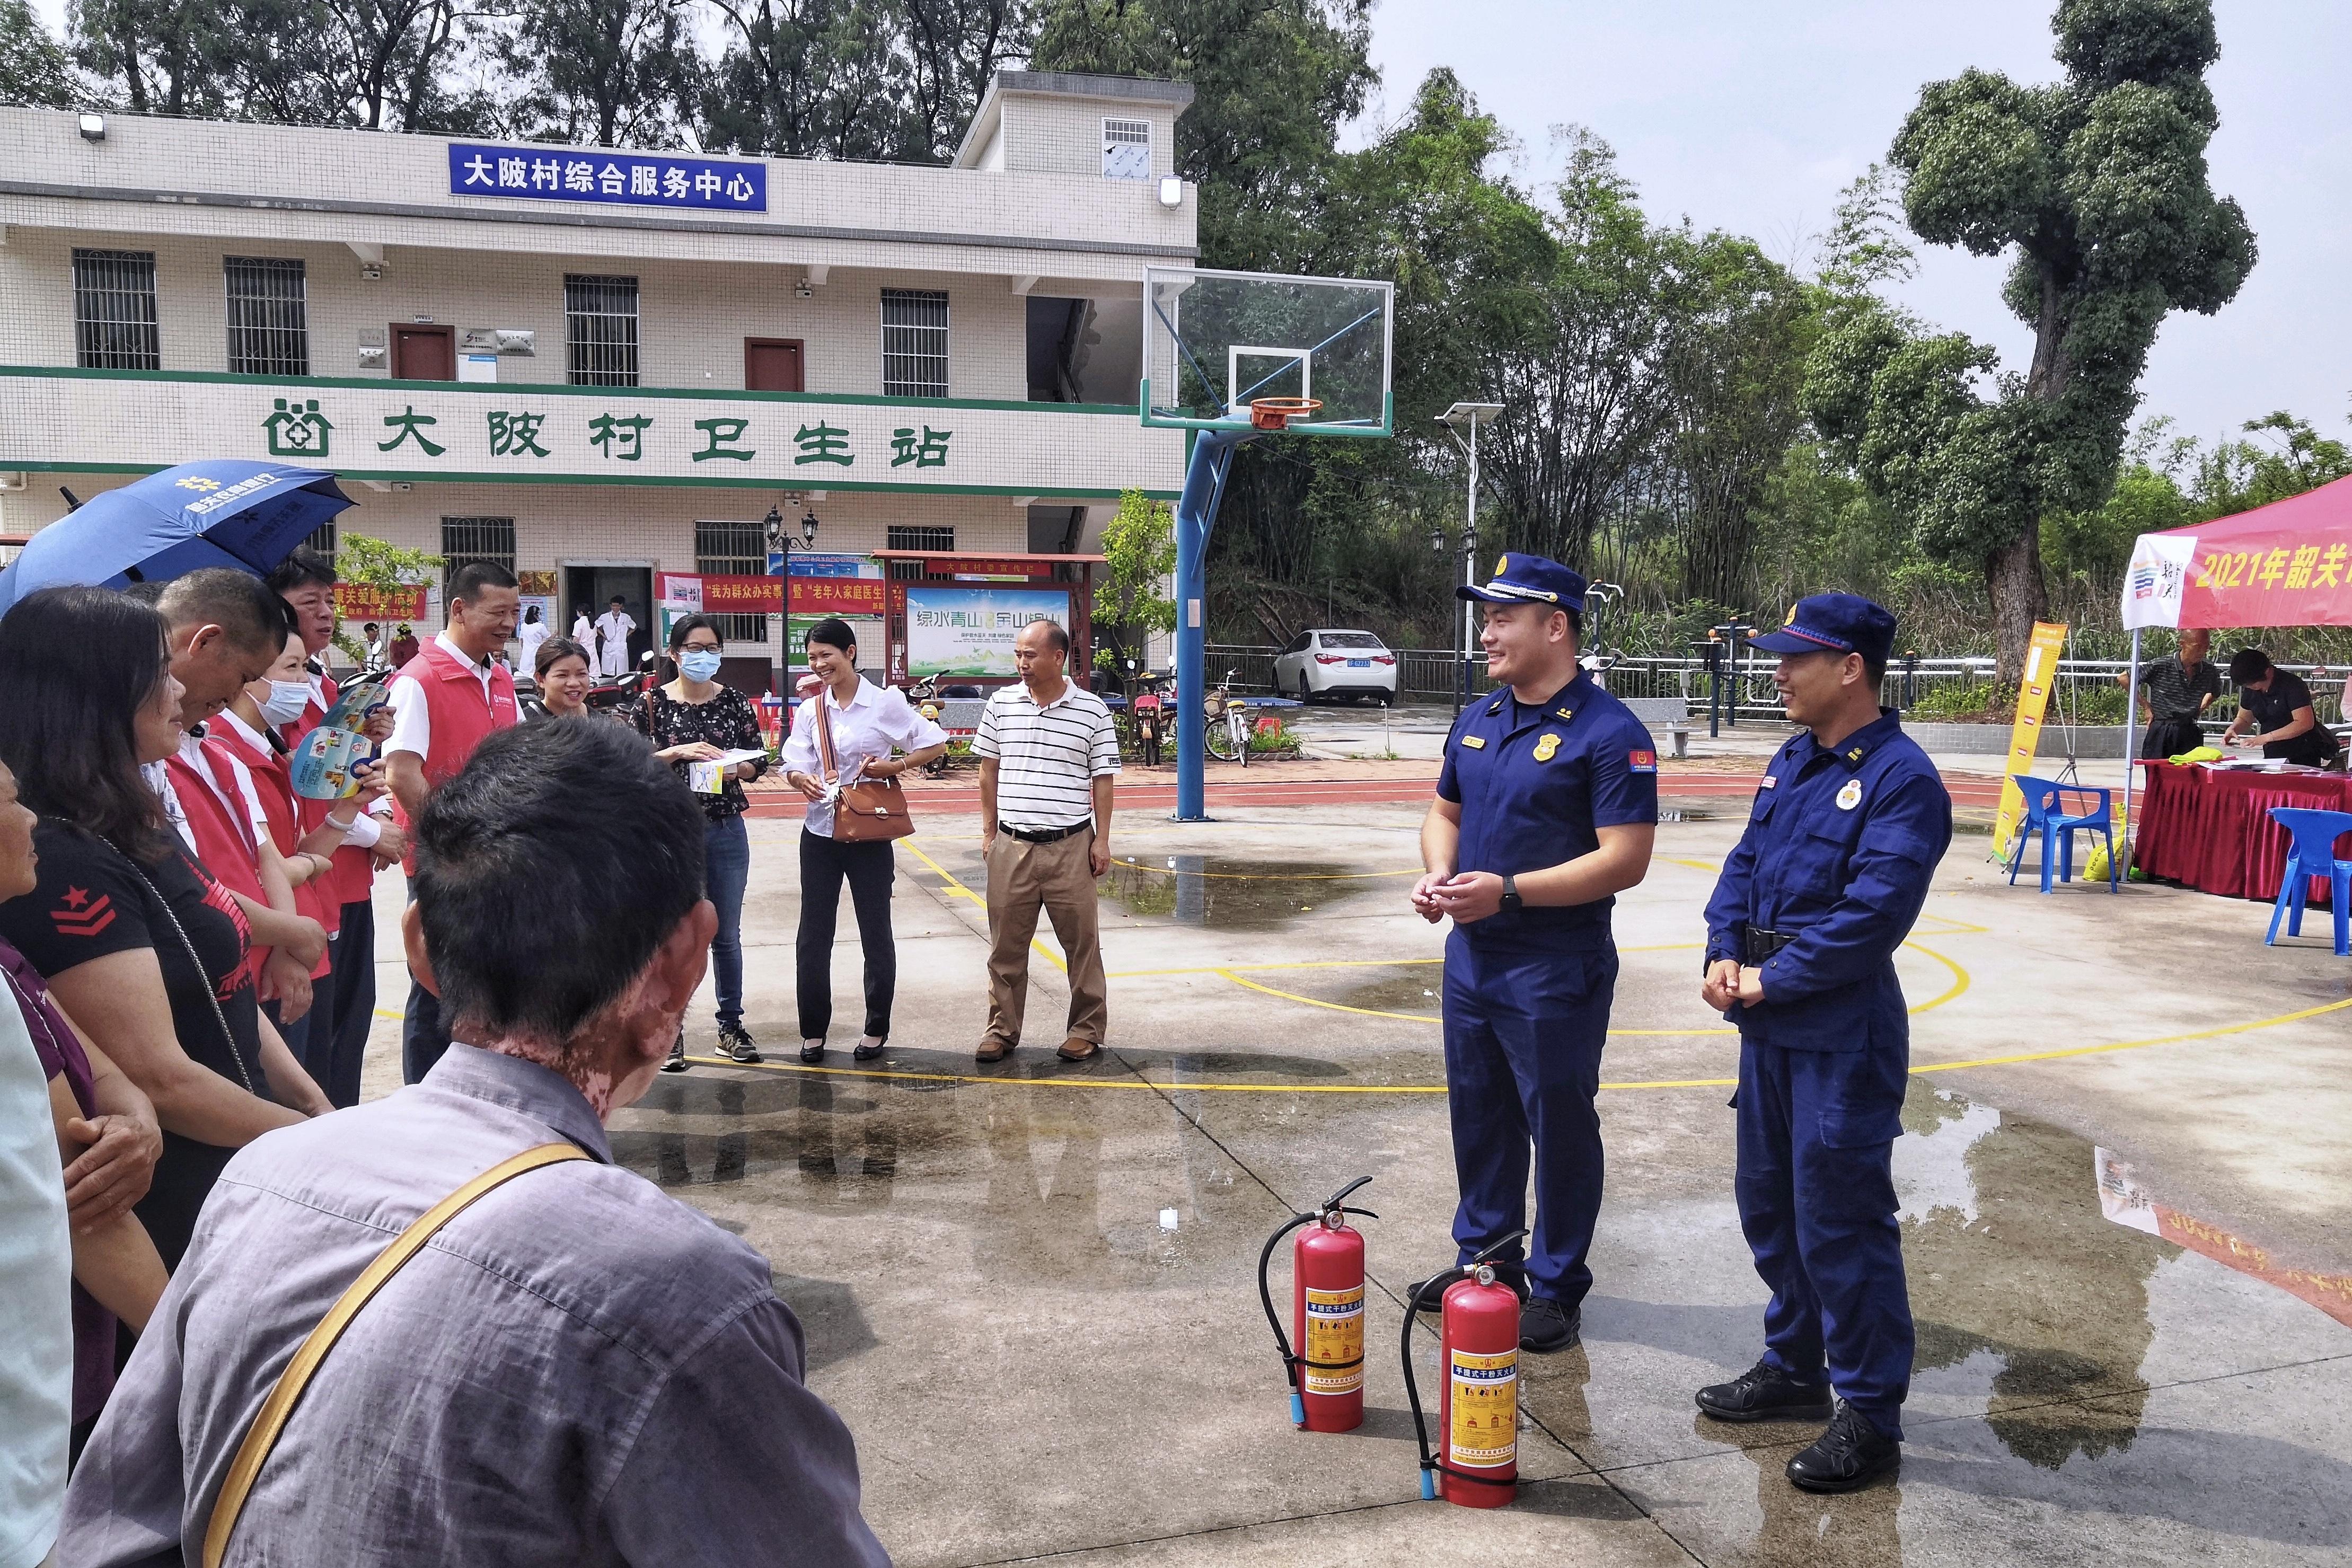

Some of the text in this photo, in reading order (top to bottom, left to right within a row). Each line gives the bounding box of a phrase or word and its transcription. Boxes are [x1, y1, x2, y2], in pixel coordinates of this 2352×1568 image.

[463, 154, 755, 201] 大陂村综合服务中心
[377, 404, 953, 468] 大陂村卫生站
[2195, 543, 2352, 590] 2021年韶关
[1456, 1366, 1514, 1378] 手提式干粉灭火器
